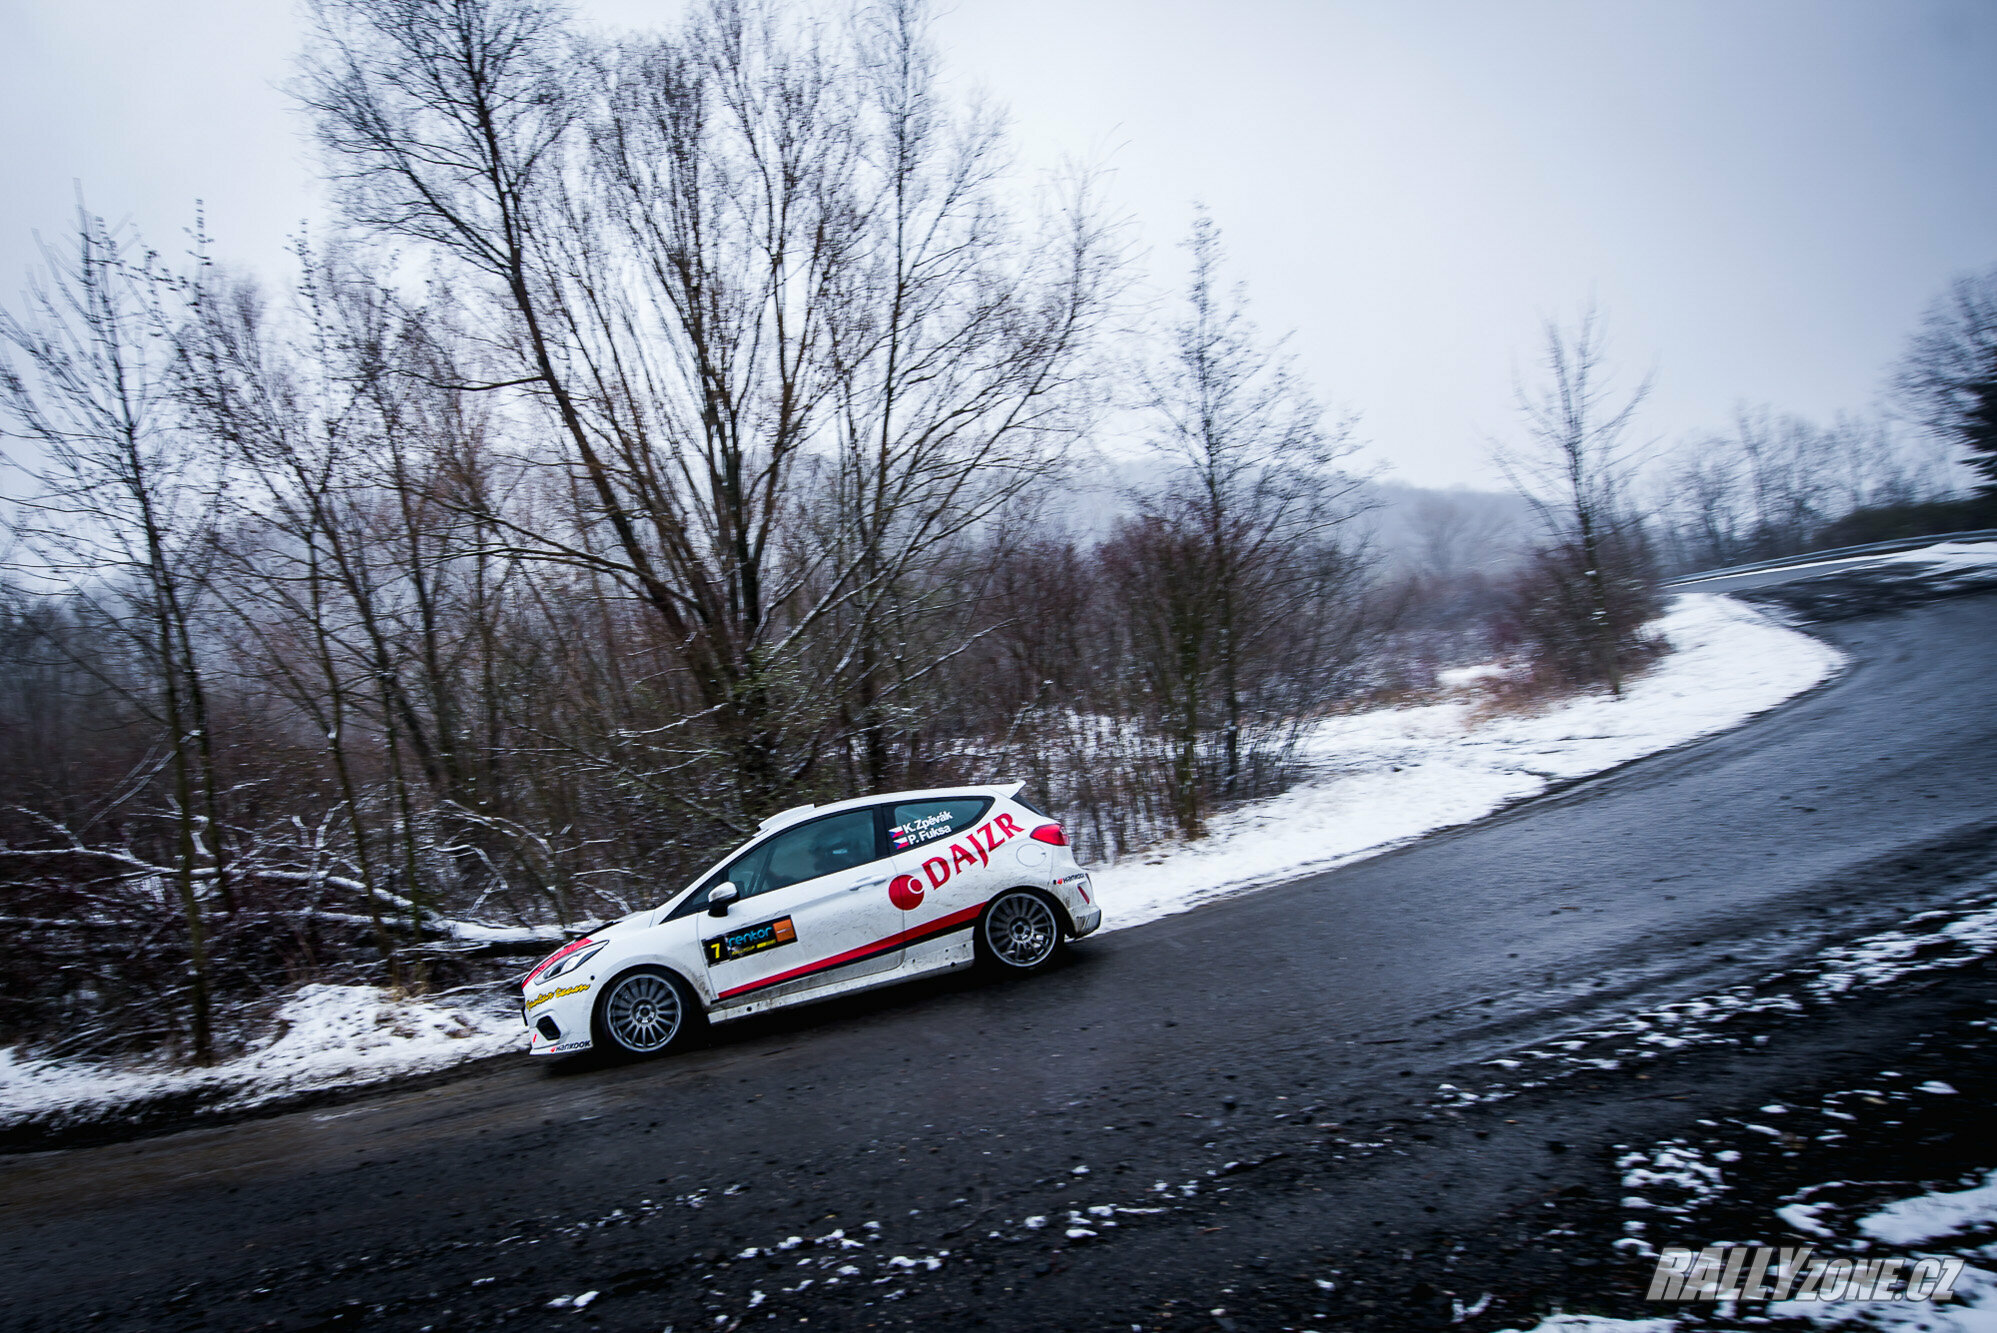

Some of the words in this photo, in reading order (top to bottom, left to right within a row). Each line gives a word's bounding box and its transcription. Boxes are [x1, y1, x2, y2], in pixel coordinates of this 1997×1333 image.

[907, 834, 920, 845] P.
[919, 825, 953, 842] Fuksa
[921, 813, 1026, 890] DAJZR
[710, 943, 720, 959] 7
[728, 926, 772, 947] rentor
